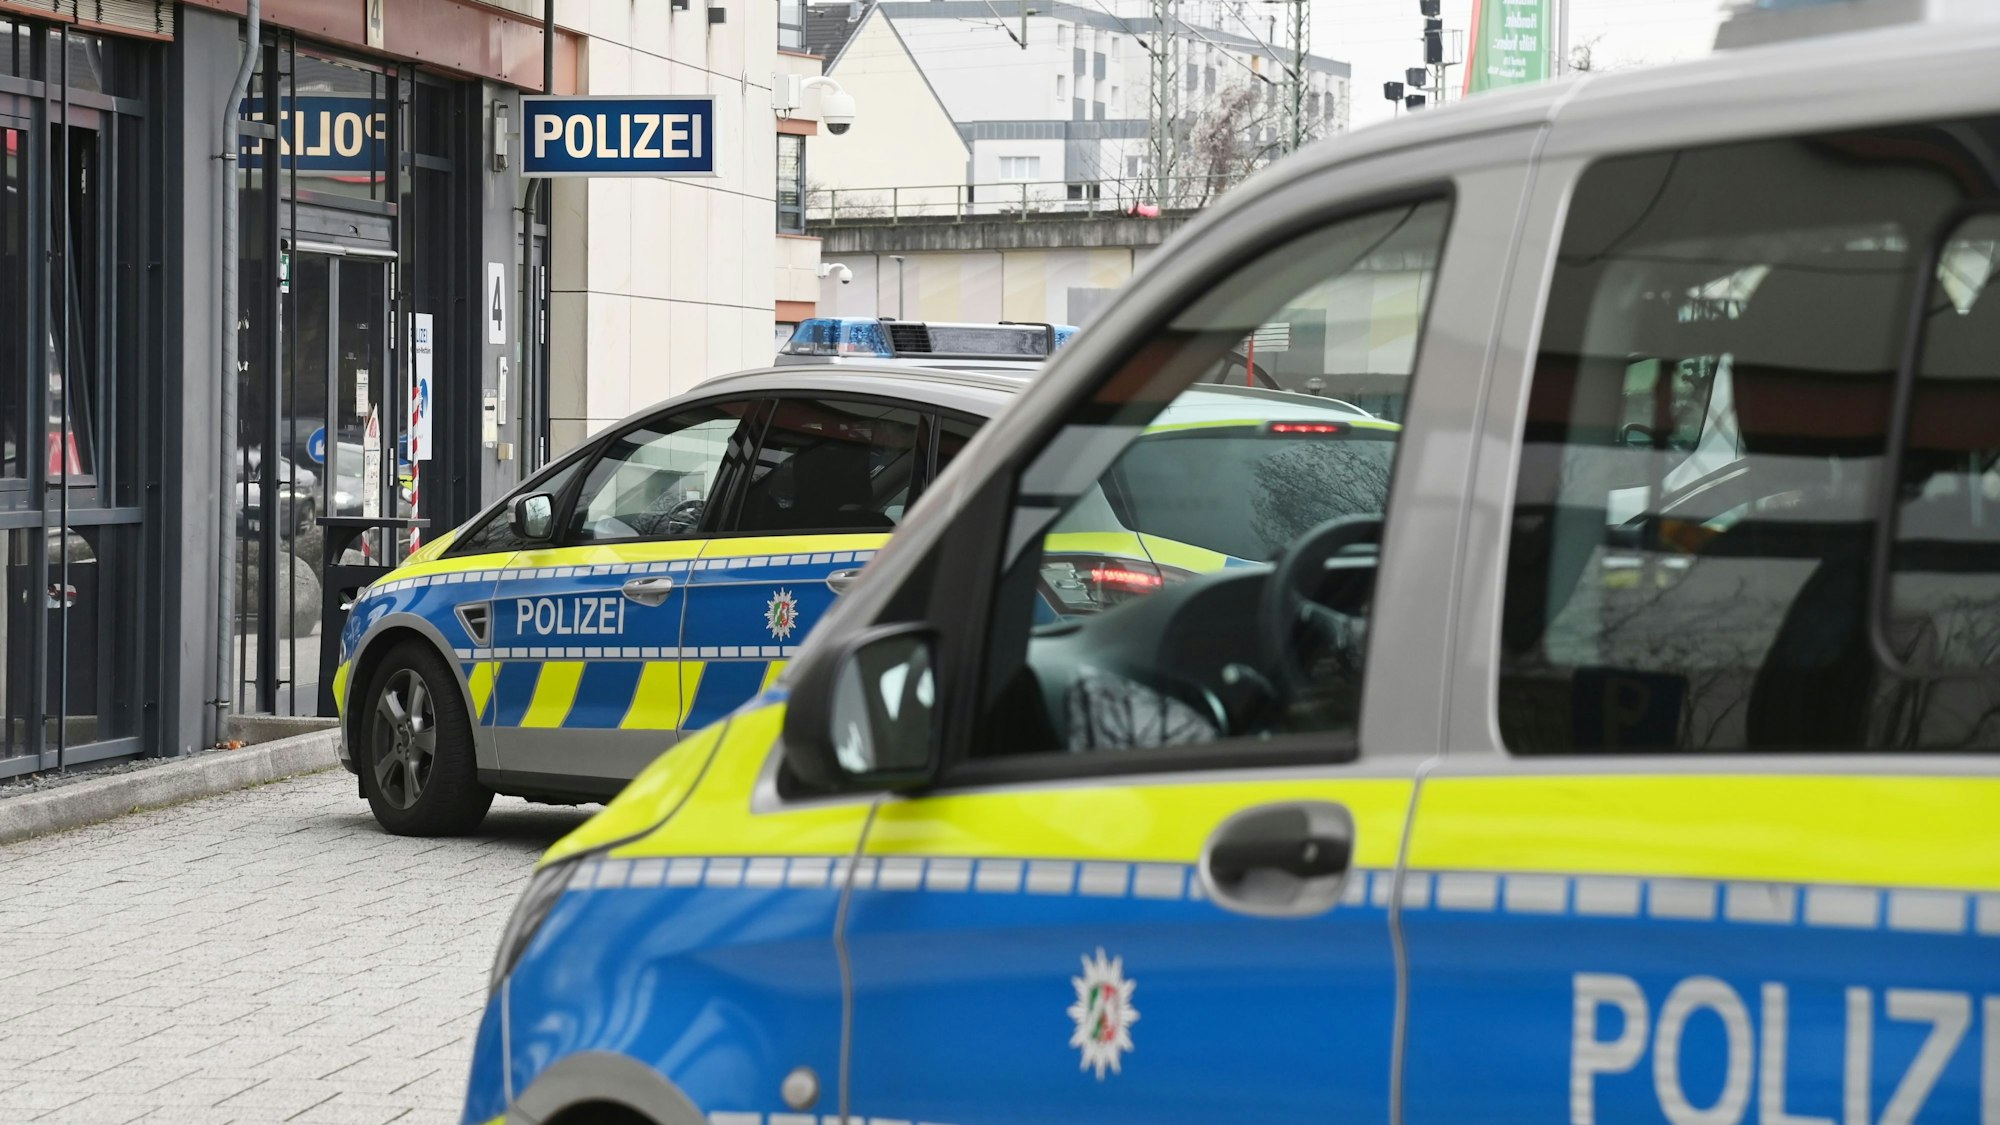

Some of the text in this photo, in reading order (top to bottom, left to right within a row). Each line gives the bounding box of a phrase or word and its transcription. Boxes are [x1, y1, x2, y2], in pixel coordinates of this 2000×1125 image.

[534, 114, 702, 158] POLIZEI
[492, 275, 503, 331] 4
[516, 597, 625, 636] POLIZEI
[1570, 972, 2000, 1125] POLIZ
